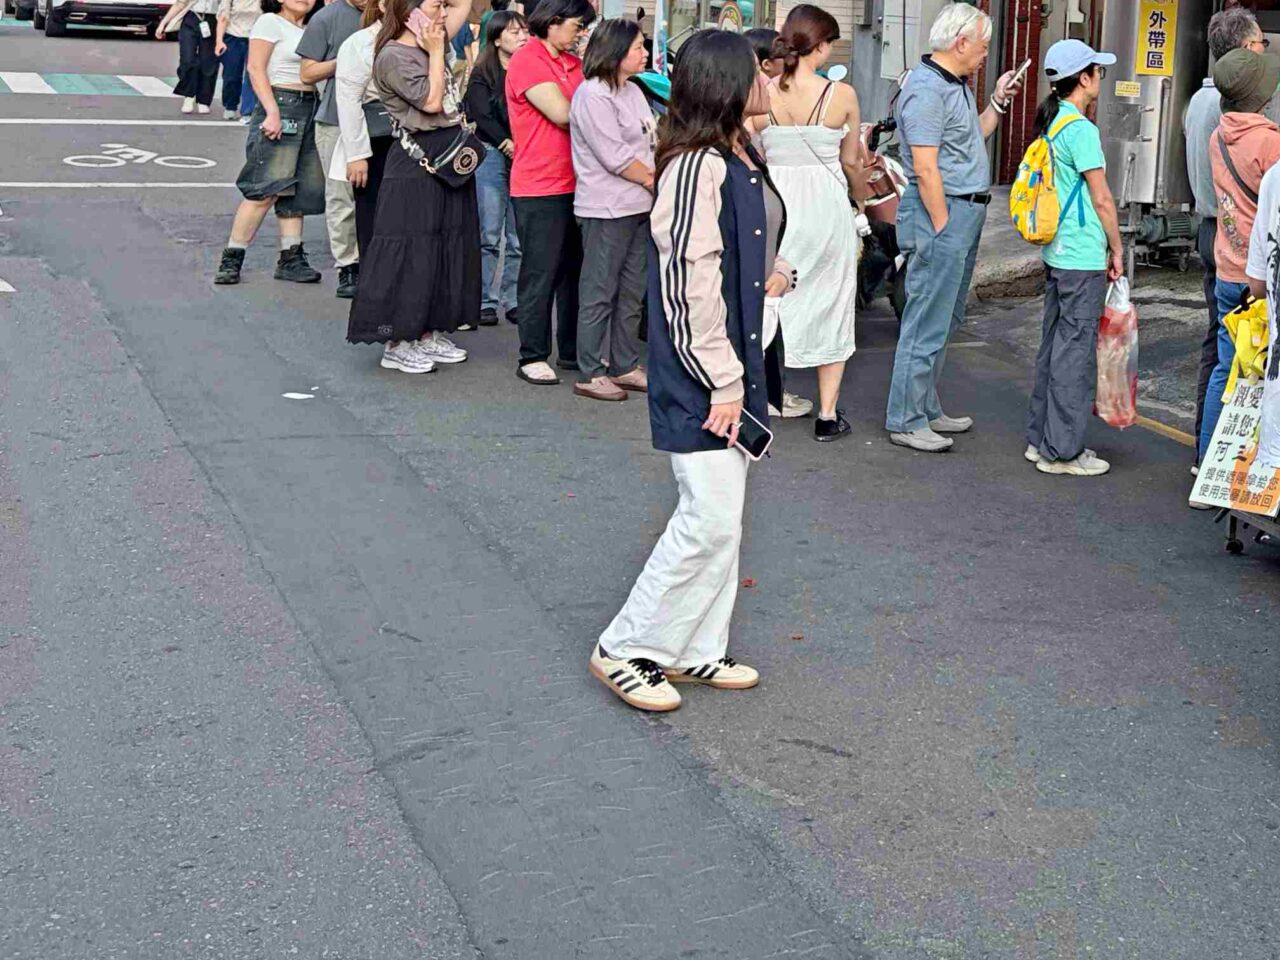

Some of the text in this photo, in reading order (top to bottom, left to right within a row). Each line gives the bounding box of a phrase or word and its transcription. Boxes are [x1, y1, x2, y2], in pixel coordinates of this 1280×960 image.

[1147, 10, 1167, 69] 外帶區
[1222, 412, 1262, 438] 請您
